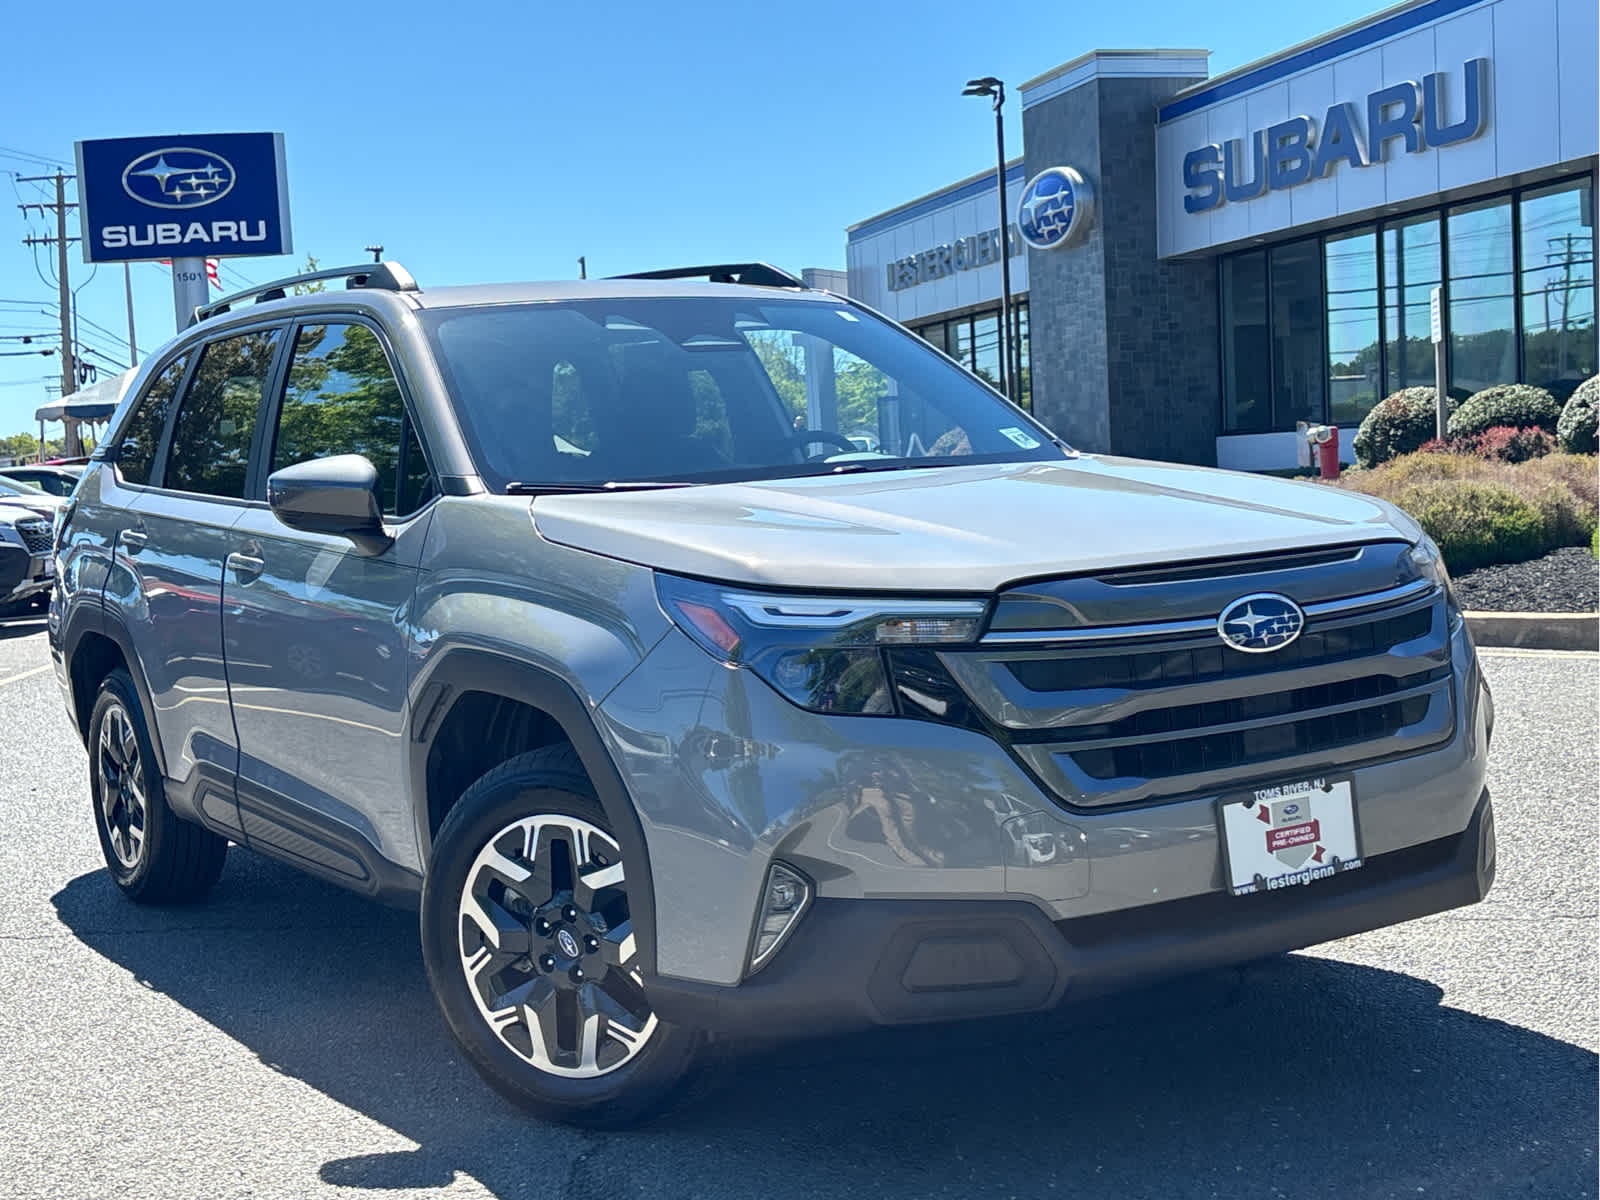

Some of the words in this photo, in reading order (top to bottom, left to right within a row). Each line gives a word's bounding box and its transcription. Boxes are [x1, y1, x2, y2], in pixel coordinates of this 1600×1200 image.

[1183, 57, 1488, 214] SUBARU
[102, 220, 267, 247] SUBARU
[177, 271, 202, 282] 1501
[887, 243, 953, 292] LESTER
[1254, 787, 1281, 800] TOMS
[1314, 777, 1326, 789] NJ
[1272, 833, 1315, 847] PRE-OWNED
[1275, 826, 1311, 839] CERTIFIED
